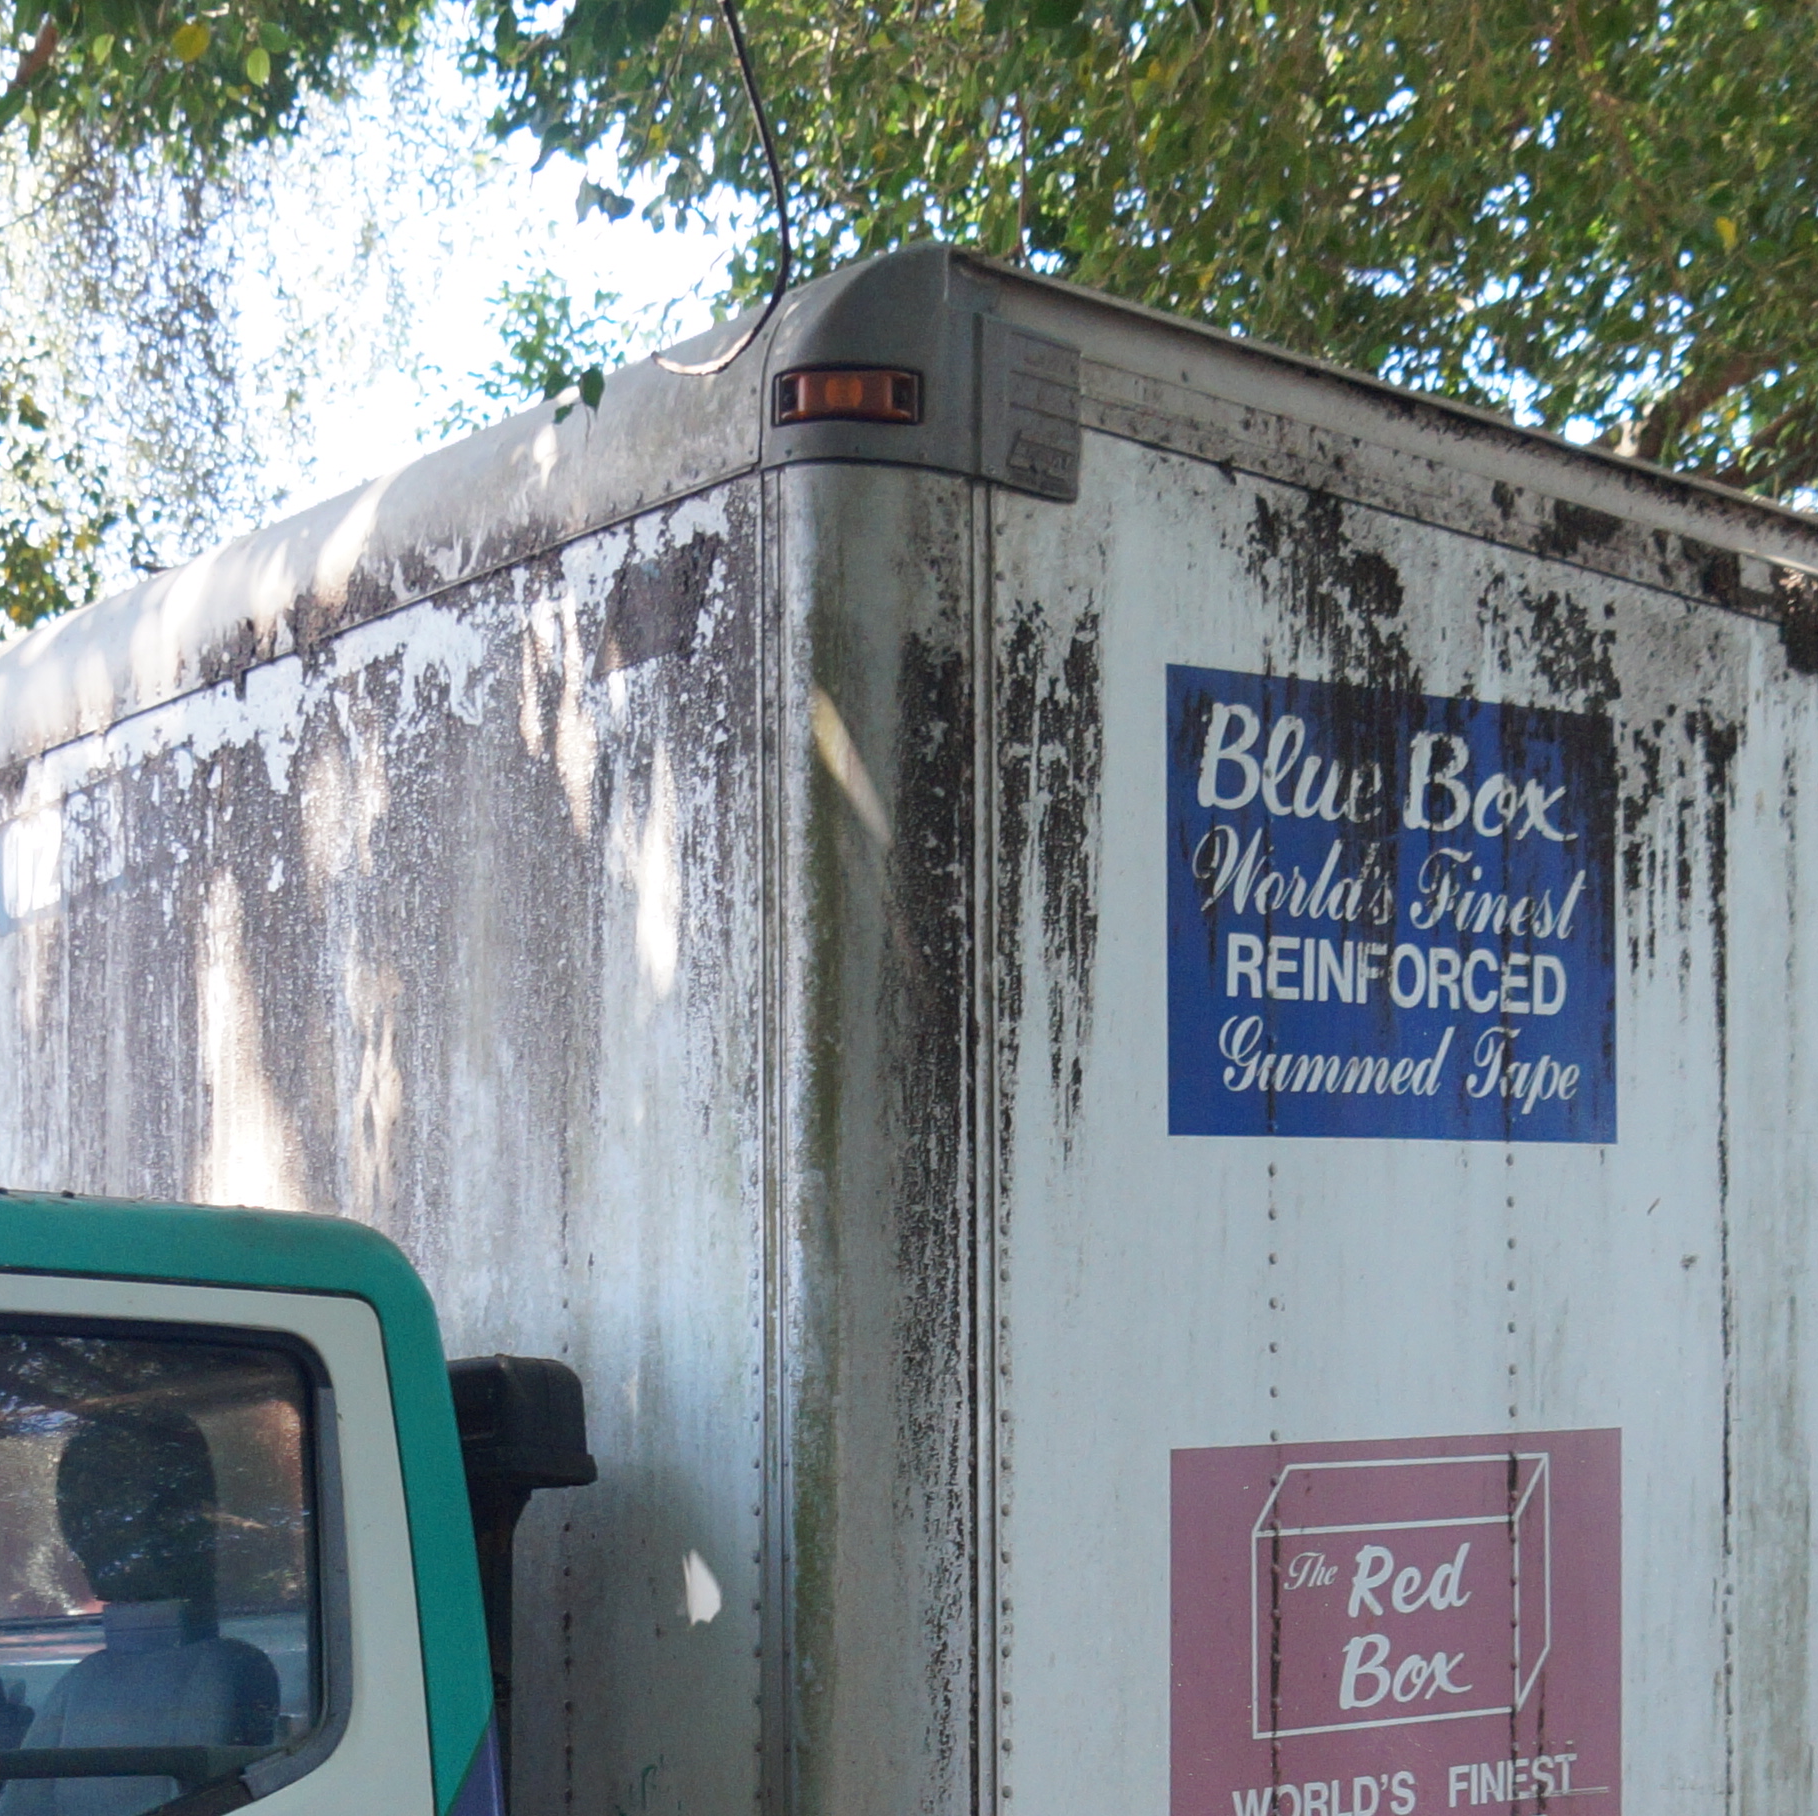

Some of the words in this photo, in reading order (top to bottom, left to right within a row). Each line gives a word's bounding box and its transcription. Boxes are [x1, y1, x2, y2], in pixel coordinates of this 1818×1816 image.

[1196, 703, 1383, 823] Blue
[1402, 731, 1578, 842] Box
[1192, 825, 1394, 925] World's
[1408, 848, 1584, 939] Finest
[1226, 933, 1567, 1016] REINFORCED
[1219, 1014, 1456, 1097] Gummed
[1465, 1026, 1581, 1115] Tape
[1283, 1552, 1338, 1591] The
[1347, 1542, 1471, 1618] Red
[1339, 1634, 1472, 1710] Box
[1448, 1753, 1577, 1808] FINEST
